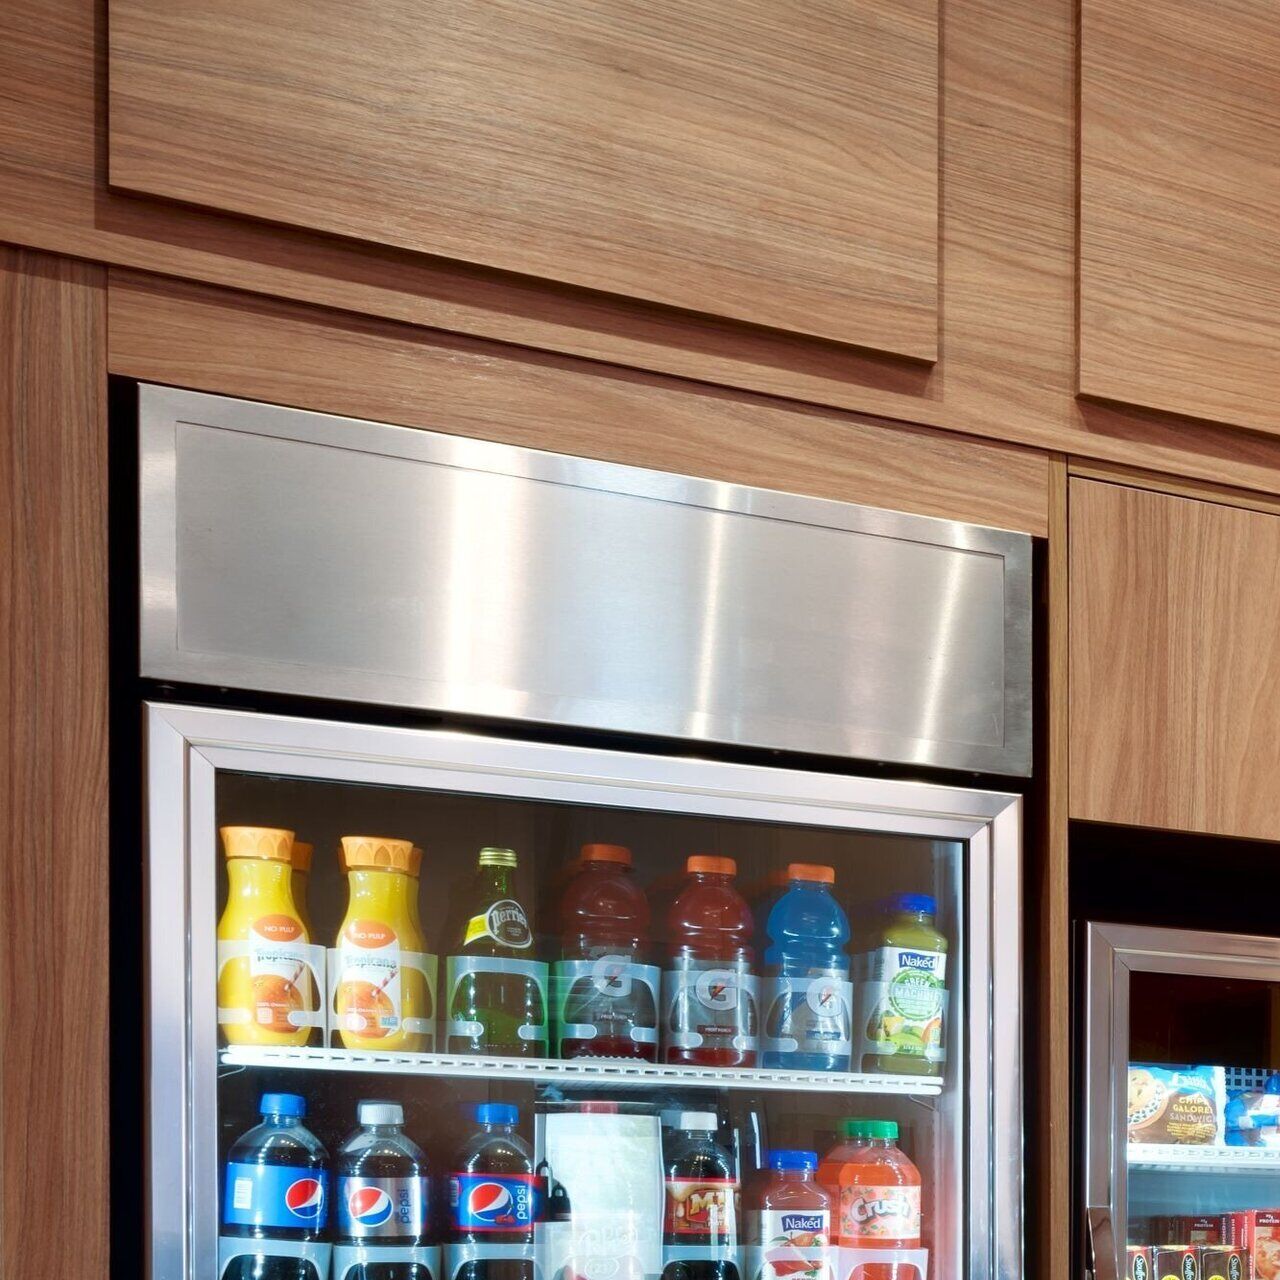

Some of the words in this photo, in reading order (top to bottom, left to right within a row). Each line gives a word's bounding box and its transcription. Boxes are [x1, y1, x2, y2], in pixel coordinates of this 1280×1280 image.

[901, 954, 936, 969] Naked
[399, 1188, 412, 1225] pepsi
[516, 1184, 528, 1220] pepsi
[850, 1196, 911, 1224] Crush
[784, 1216, 821, 1230] Naked
